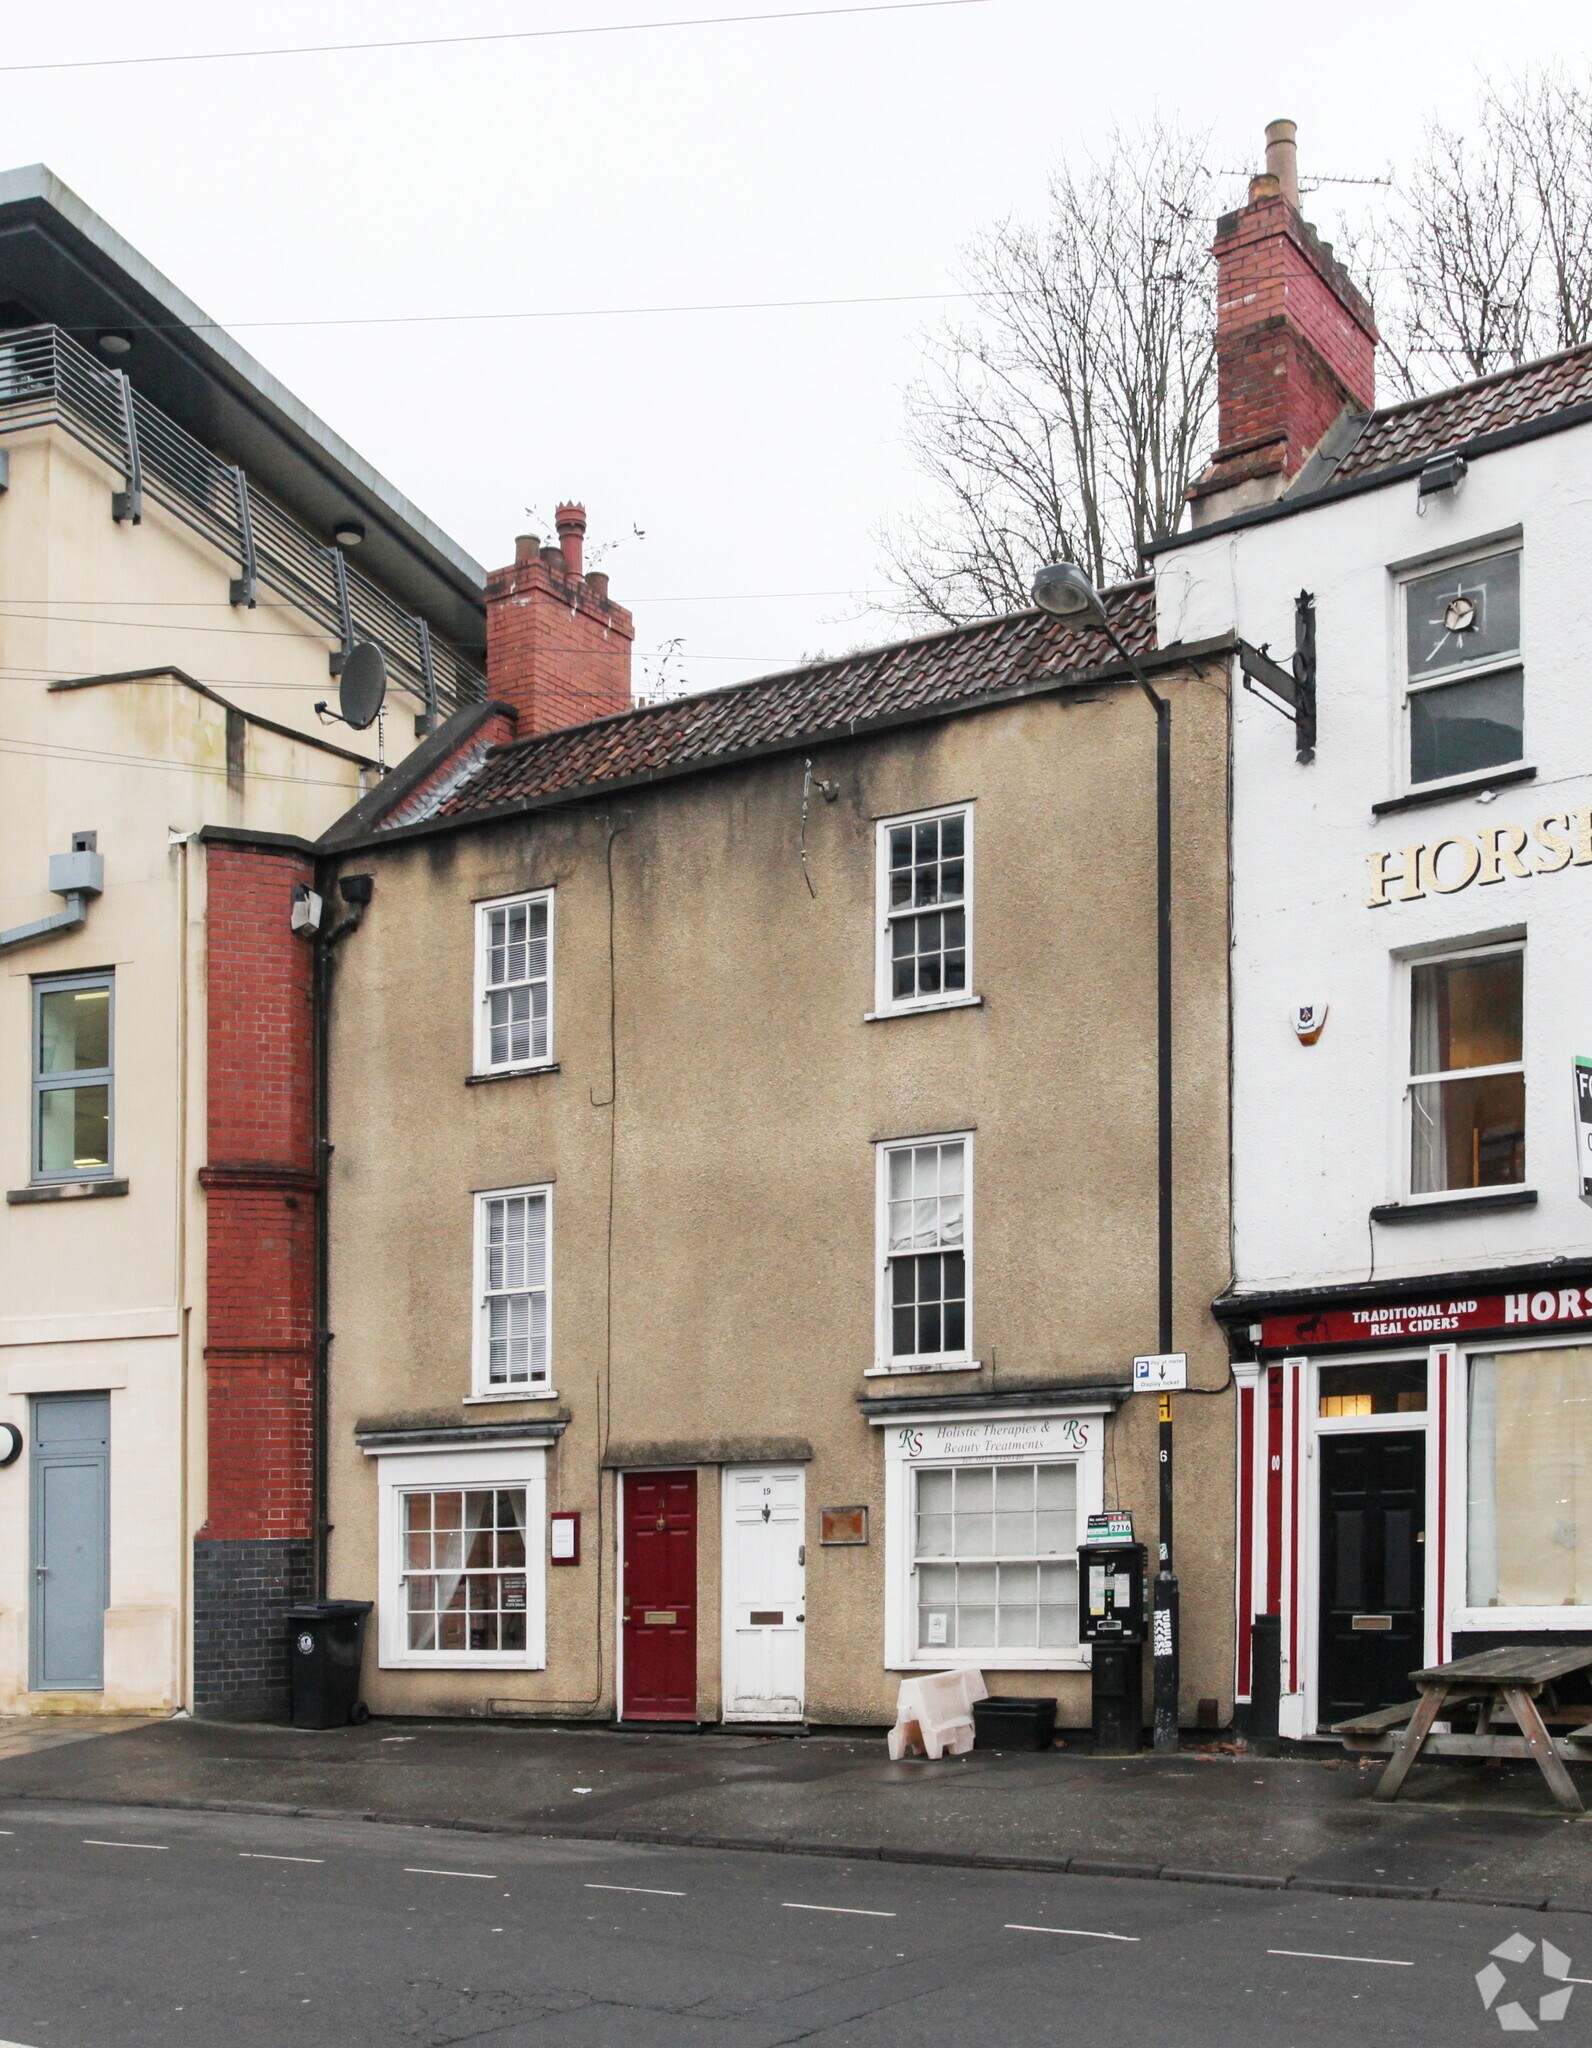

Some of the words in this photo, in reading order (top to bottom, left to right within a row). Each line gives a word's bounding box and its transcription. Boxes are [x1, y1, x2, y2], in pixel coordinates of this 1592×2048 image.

[1352, 1305, 1444, 1324] TRADITIONAL
[1448, 1301, 1478, 1315] AND
[1370, 1322, 1404, 1336] REAL
[1408, 1317, 1459, 1333] CIDERS
[937, 1425, 979, 1439] Holistic
[983, 1422, 1037, 1438] Therapies
[1040, 1421, 1050, 1433] &
[944, 1441, 981, 1454] Beauty
[985, 1439, 1044, 1452] Treatments
[1160, 1450, 1168, 1462] 6
[763, 1487, 771, 1495] 19
